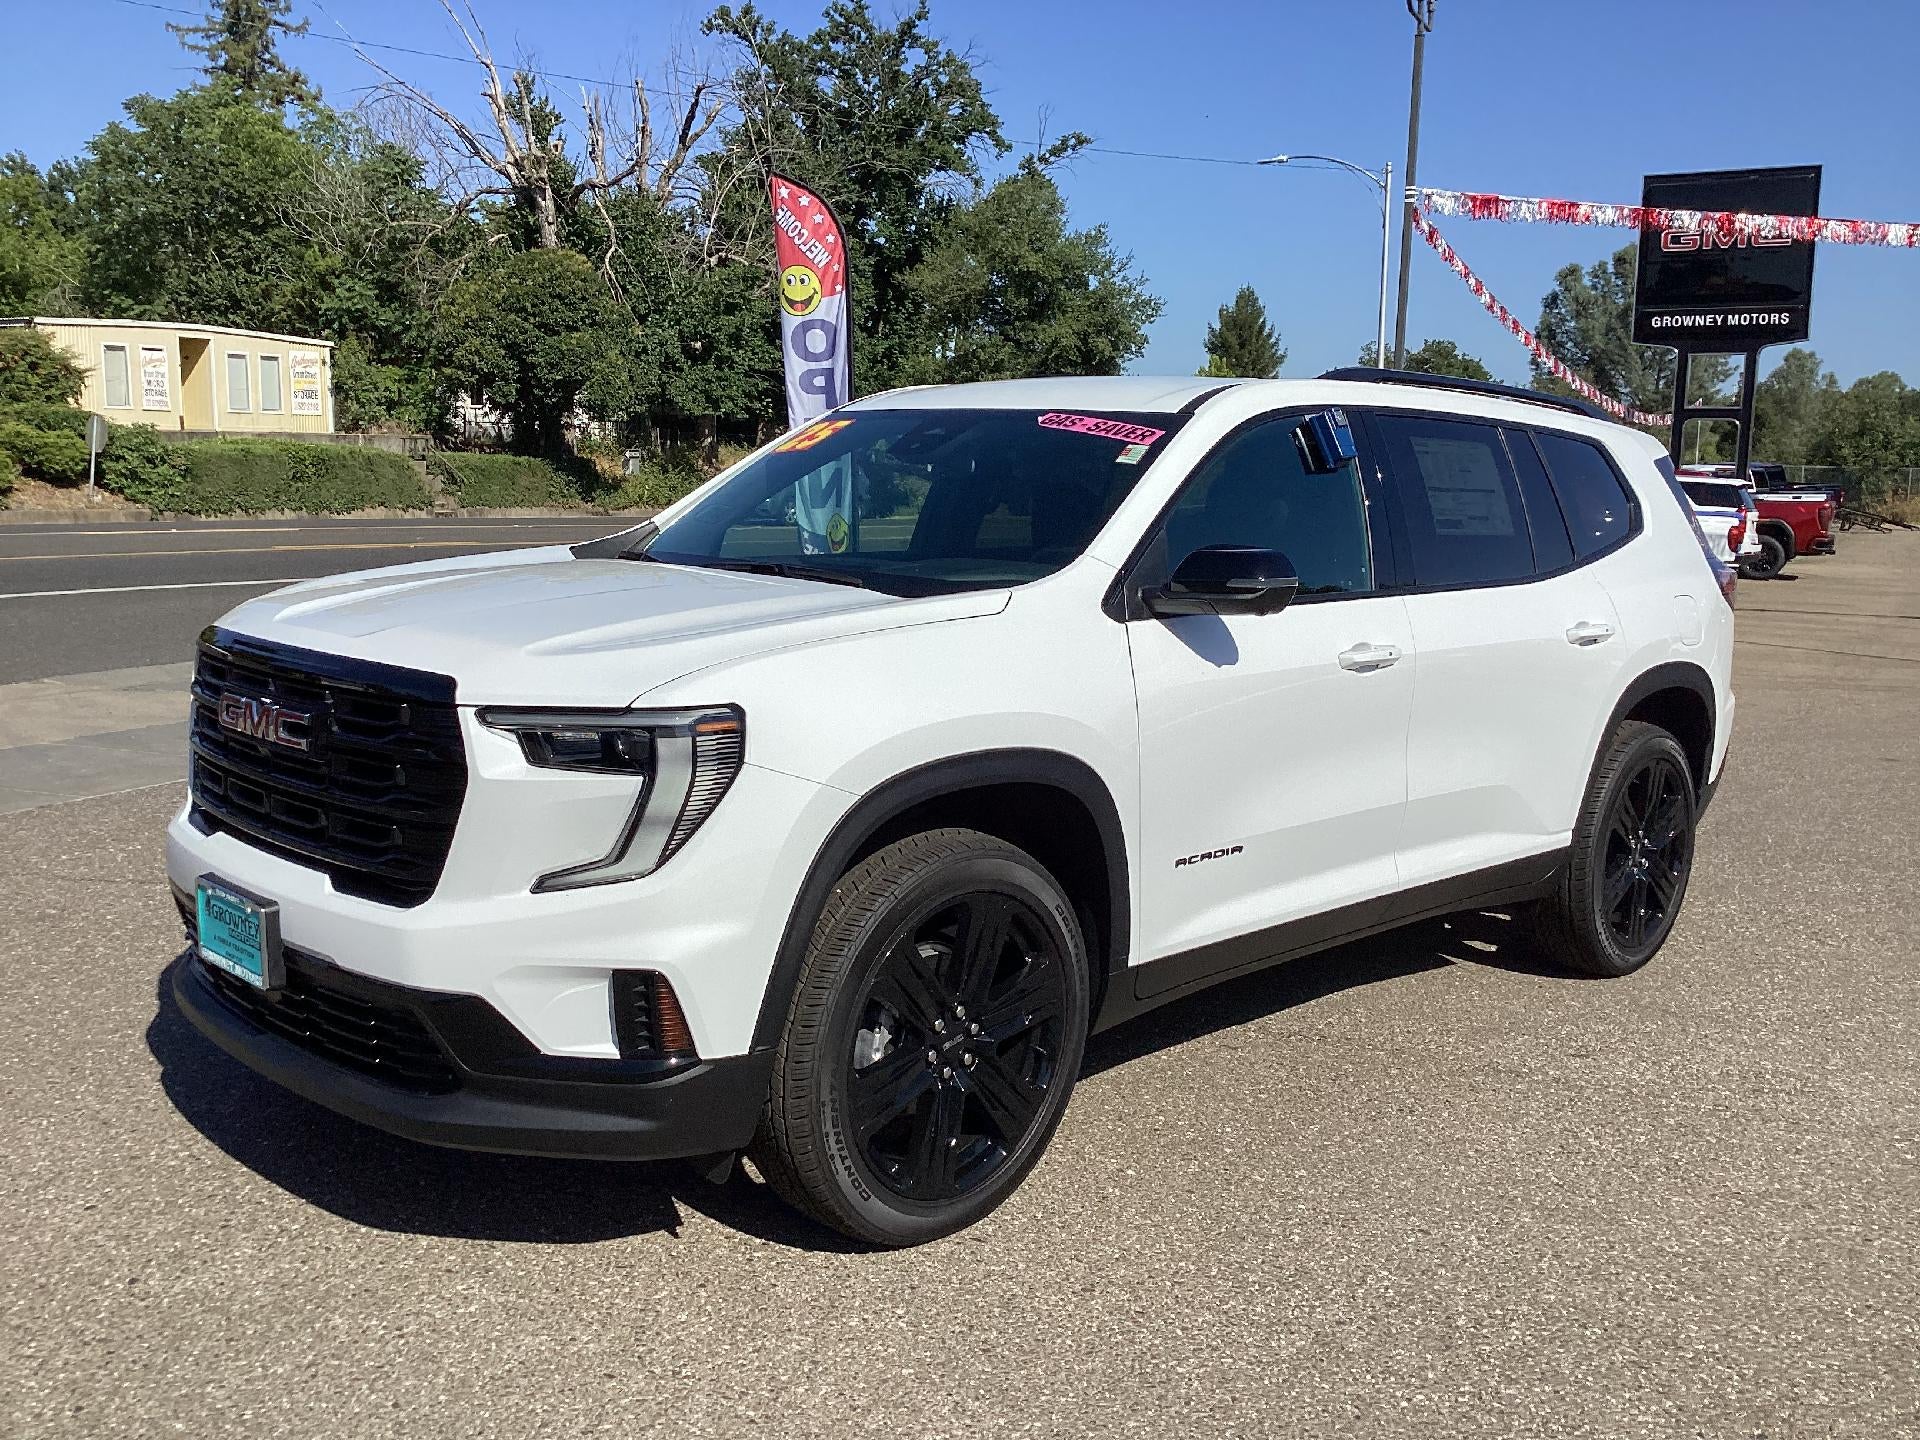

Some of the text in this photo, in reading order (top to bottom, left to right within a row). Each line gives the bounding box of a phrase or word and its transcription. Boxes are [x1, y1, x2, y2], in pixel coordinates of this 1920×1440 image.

[1651, 312, 1790, 328] GROWNEY MOTORS
[144, 388, 168, 398] STORAGE
[293, 390, 319, 400] STORAGE
[1040, 414, 1084, 428] GAS
[1086, 421, 1156, 442] SAVER
[218, 692, 311, 752] GMC
[1174, 845, 1244, 868] ACADIA
[212, 903, 261, 940] GROWNEY
